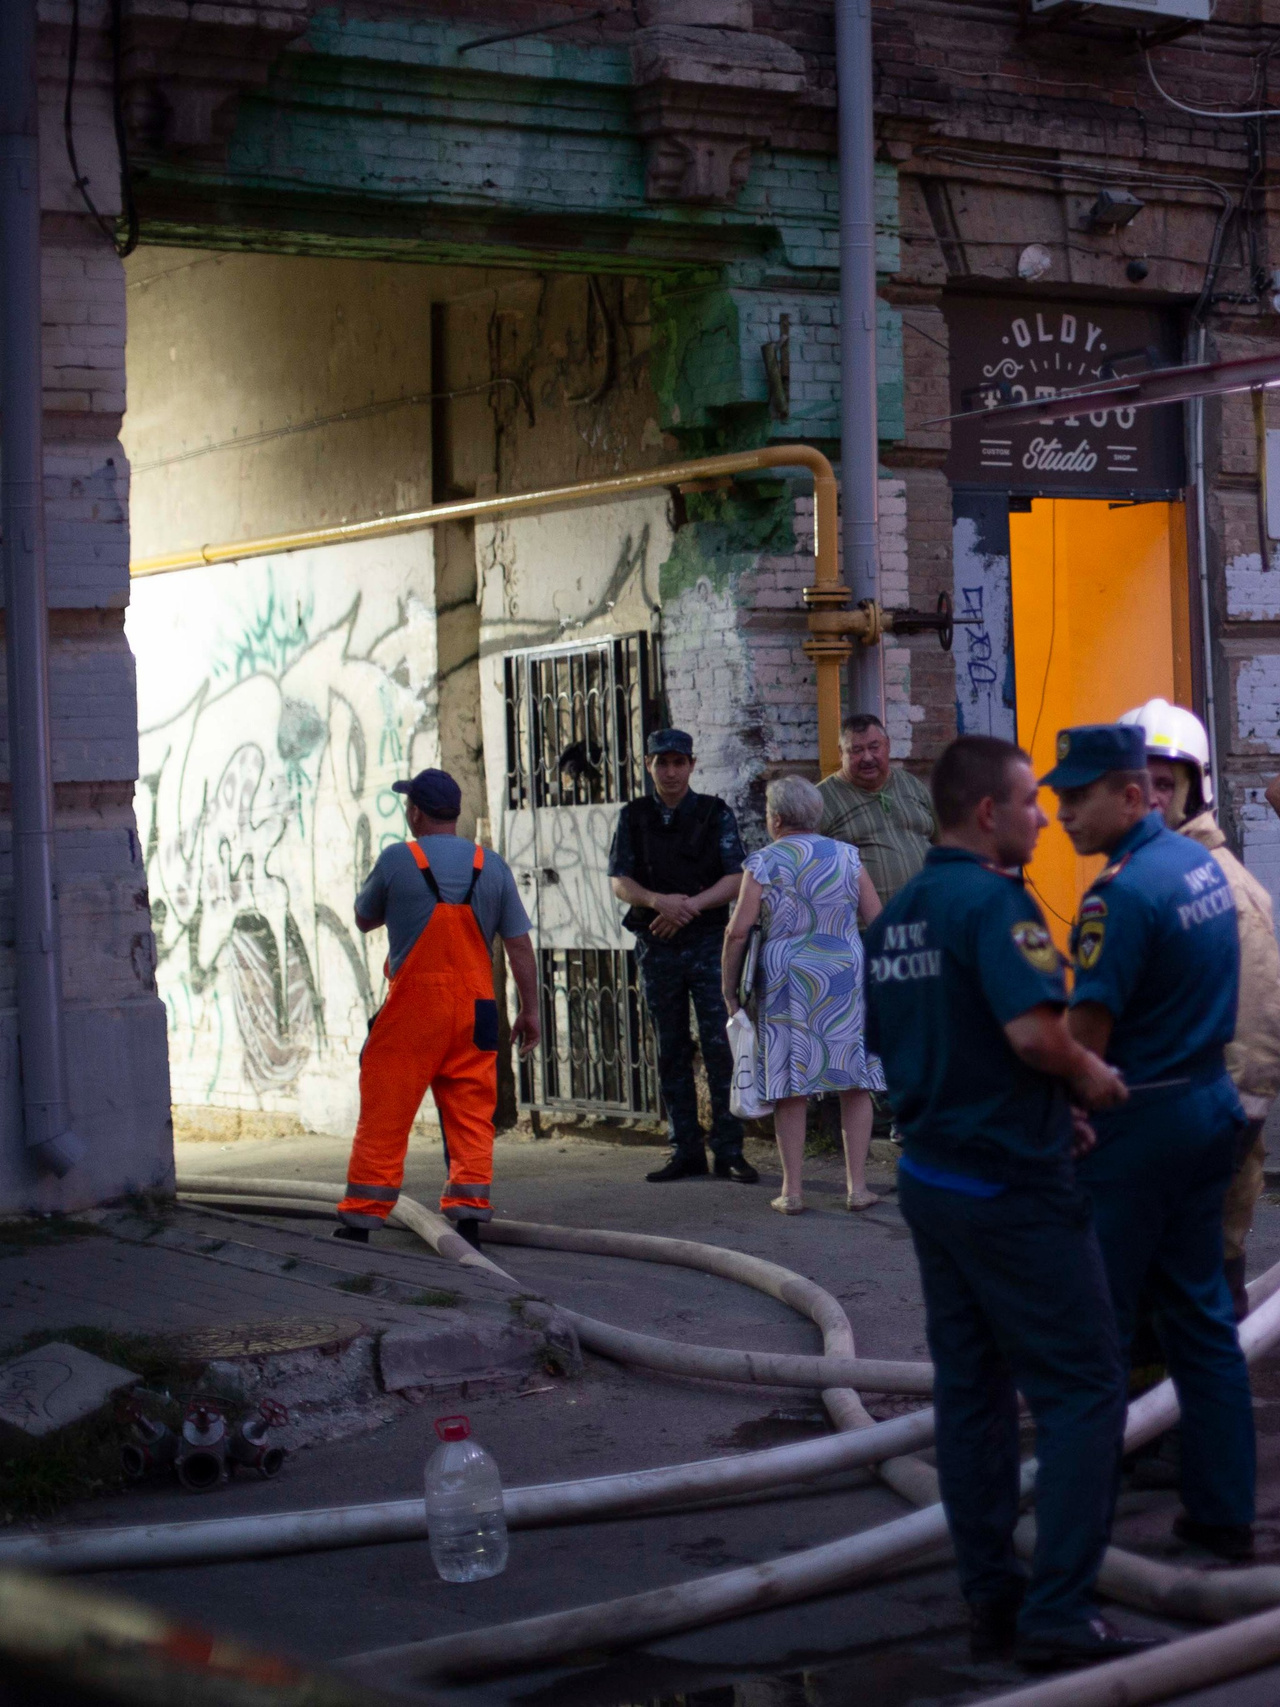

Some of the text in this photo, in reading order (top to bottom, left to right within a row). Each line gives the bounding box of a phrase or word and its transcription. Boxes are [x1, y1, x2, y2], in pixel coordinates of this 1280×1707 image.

[1011, 313, 1102, 352] OLDY
[981, 437, 1131, 472] CUSTOM Studio SHOP
[1183, 862, 1221, 895] МЧС
